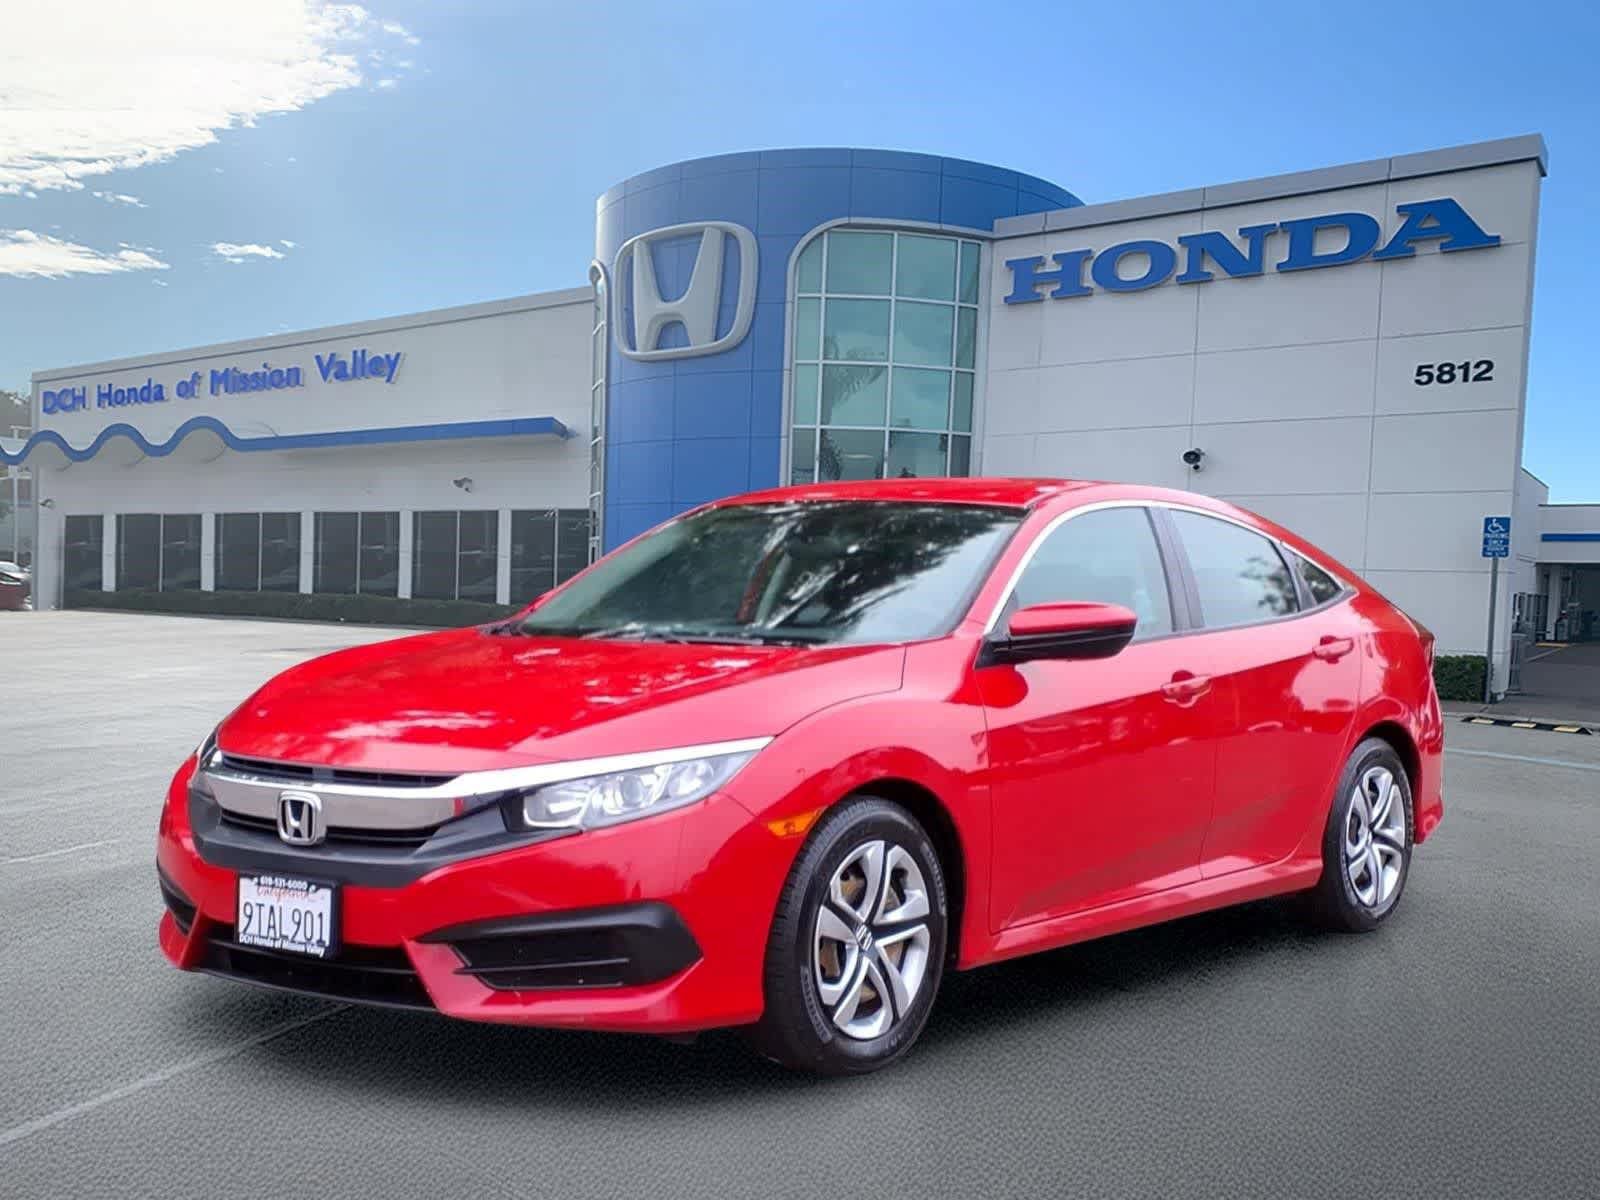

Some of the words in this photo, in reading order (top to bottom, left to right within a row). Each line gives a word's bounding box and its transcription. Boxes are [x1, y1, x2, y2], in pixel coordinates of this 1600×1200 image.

[1003, 197, 1501, 305] HONDA
[42, 386, 87, 414] DCH
[97, 378, 166, 409] Honda
[176, 371, 202, 398] of
[210, 362, 302, 396] Mission
[315, 349, 401, 383] Valley
[1414, 359, 1494, 386] 5812
[243, 901, 326, 947] 9TAL901
